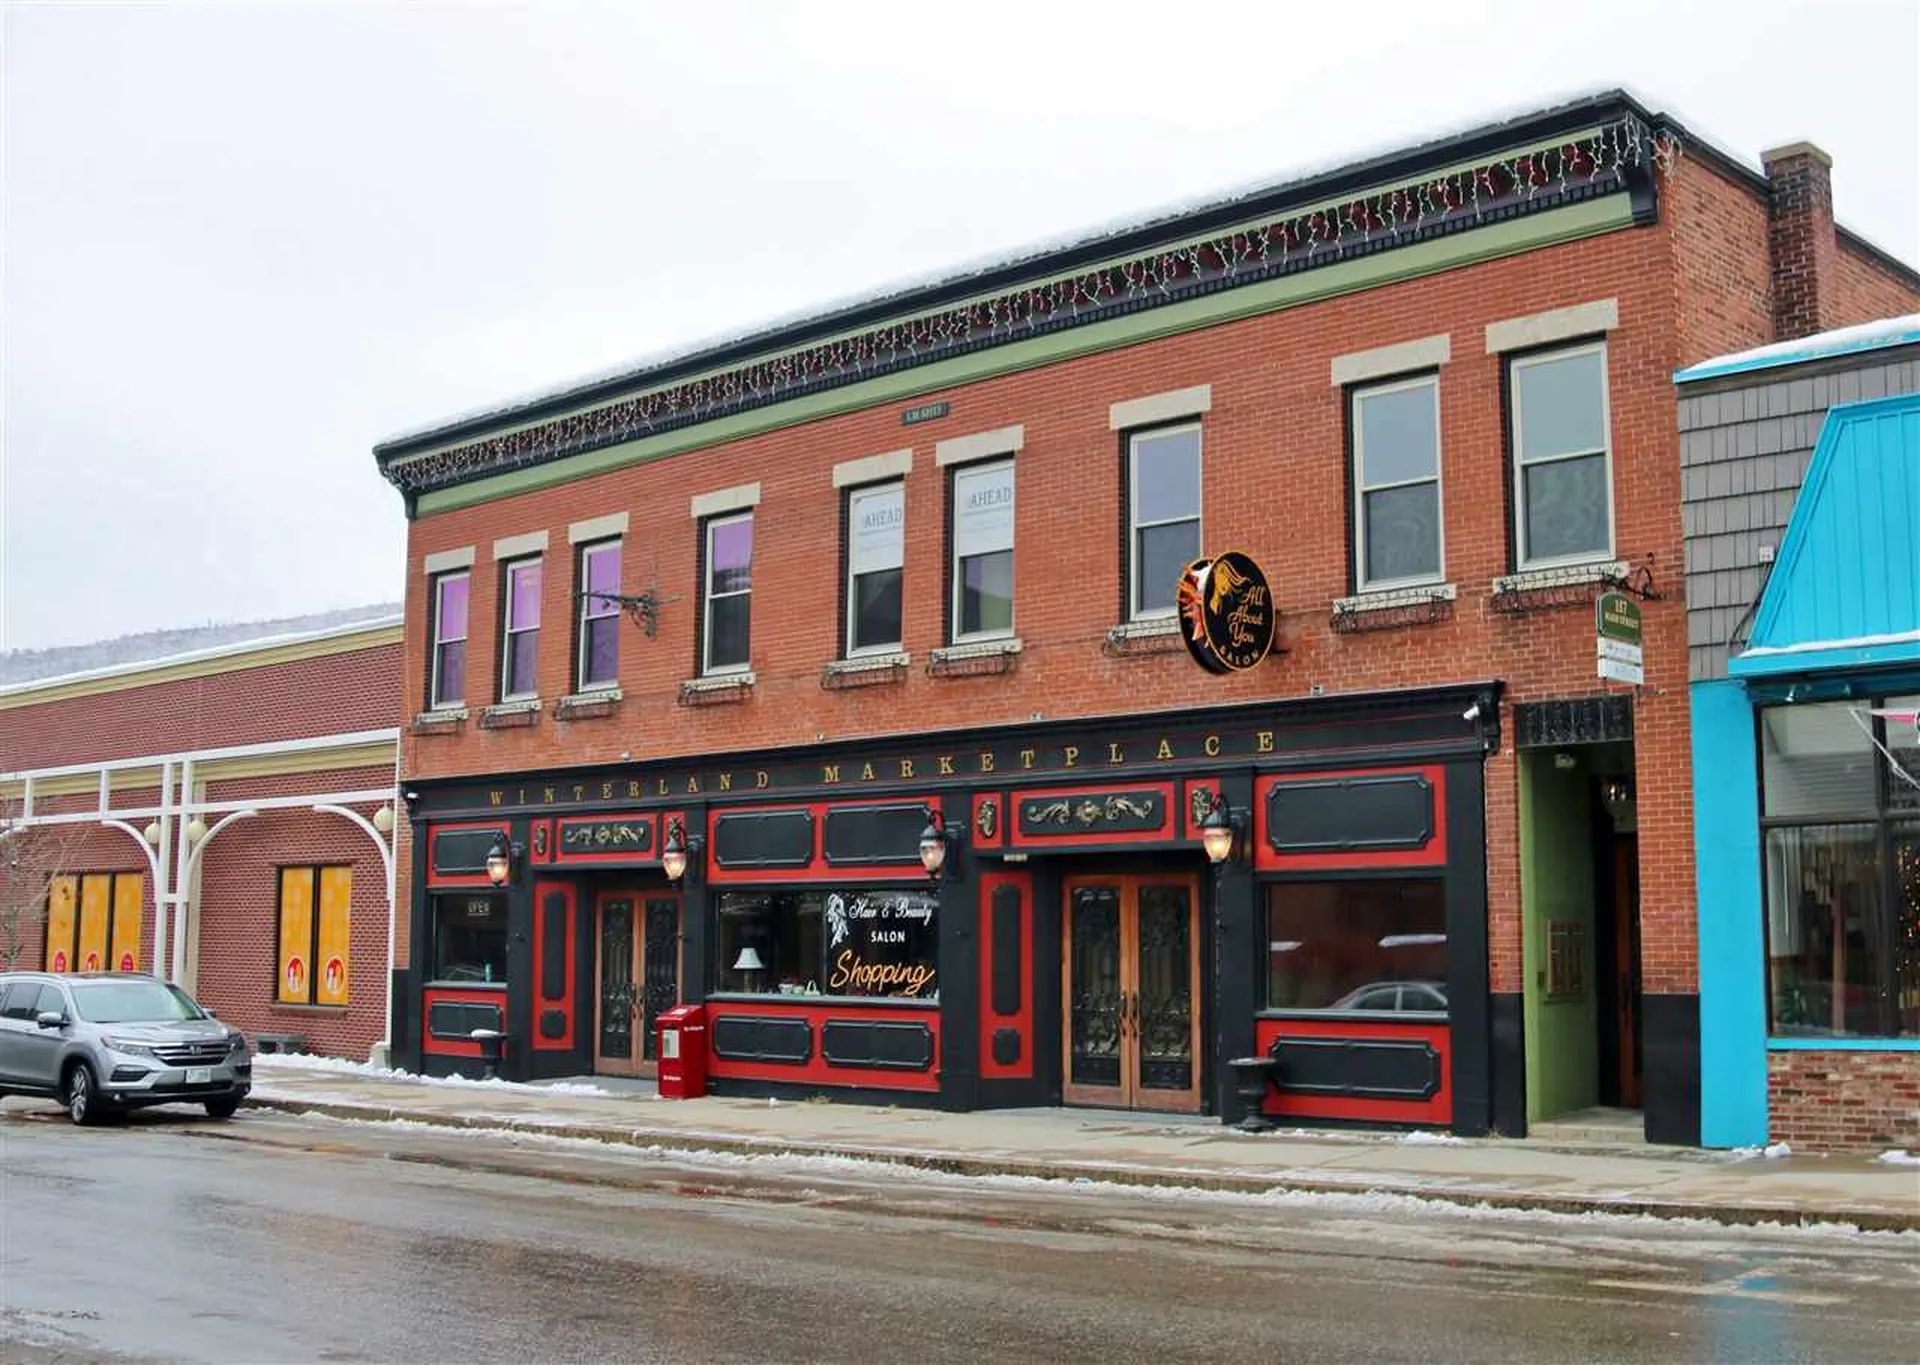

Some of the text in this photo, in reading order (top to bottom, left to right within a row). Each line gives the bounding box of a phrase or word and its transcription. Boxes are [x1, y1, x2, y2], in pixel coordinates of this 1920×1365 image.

[971, 487, 1010, 507] AHEAD
[1229, 622, 1254, 647] You
[490, 732, 1274, 805] WINTERLAND MARKETPLACE
[870, 931, 905, 942] SALON
[830, 949, 936, 995] Shopping
